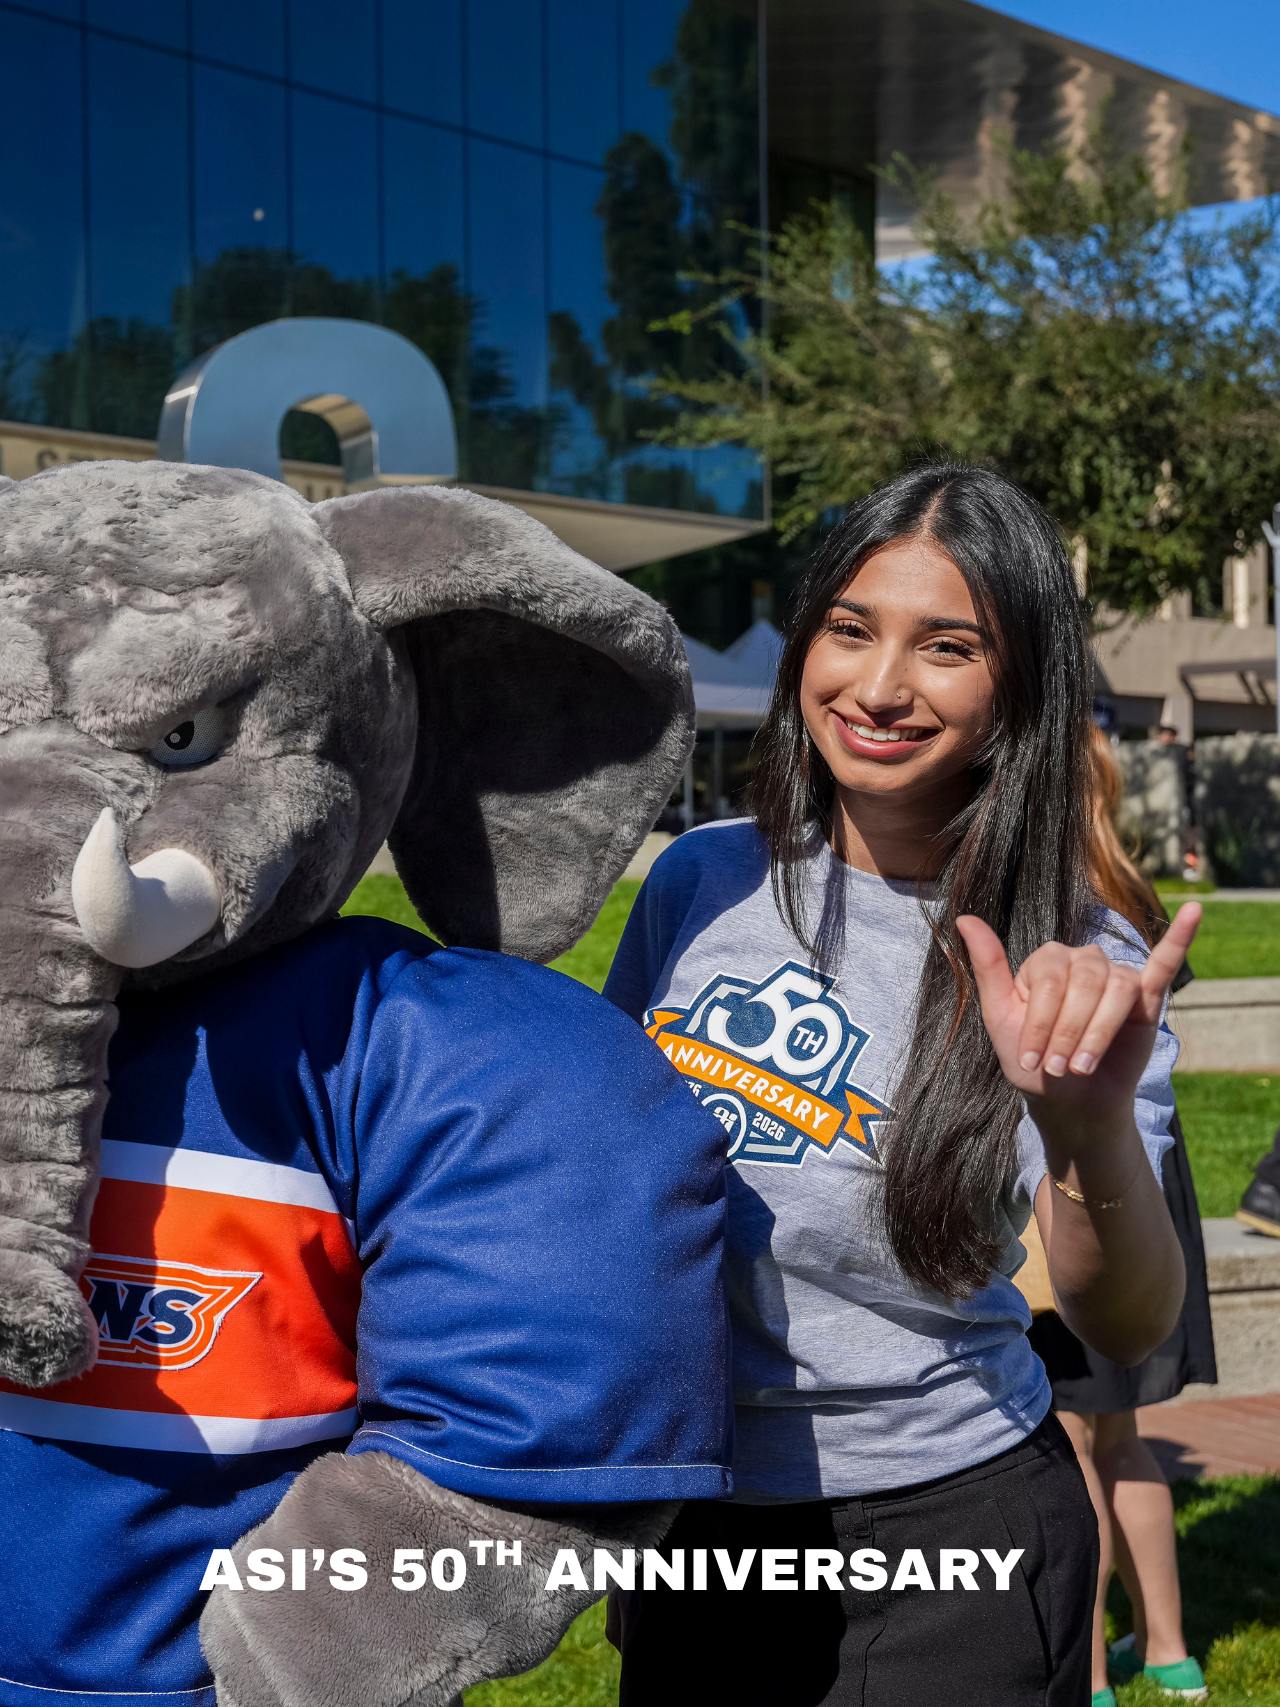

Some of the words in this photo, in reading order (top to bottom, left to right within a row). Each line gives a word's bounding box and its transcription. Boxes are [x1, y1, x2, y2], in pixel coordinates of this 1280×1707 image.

[707, 969, 843, 1076] 50
[793, 1025, 825, 1054] TH
[663, 1041, 830, 1130] ANNIVERSARY
[752, 1111, 786, 1141] 2026
